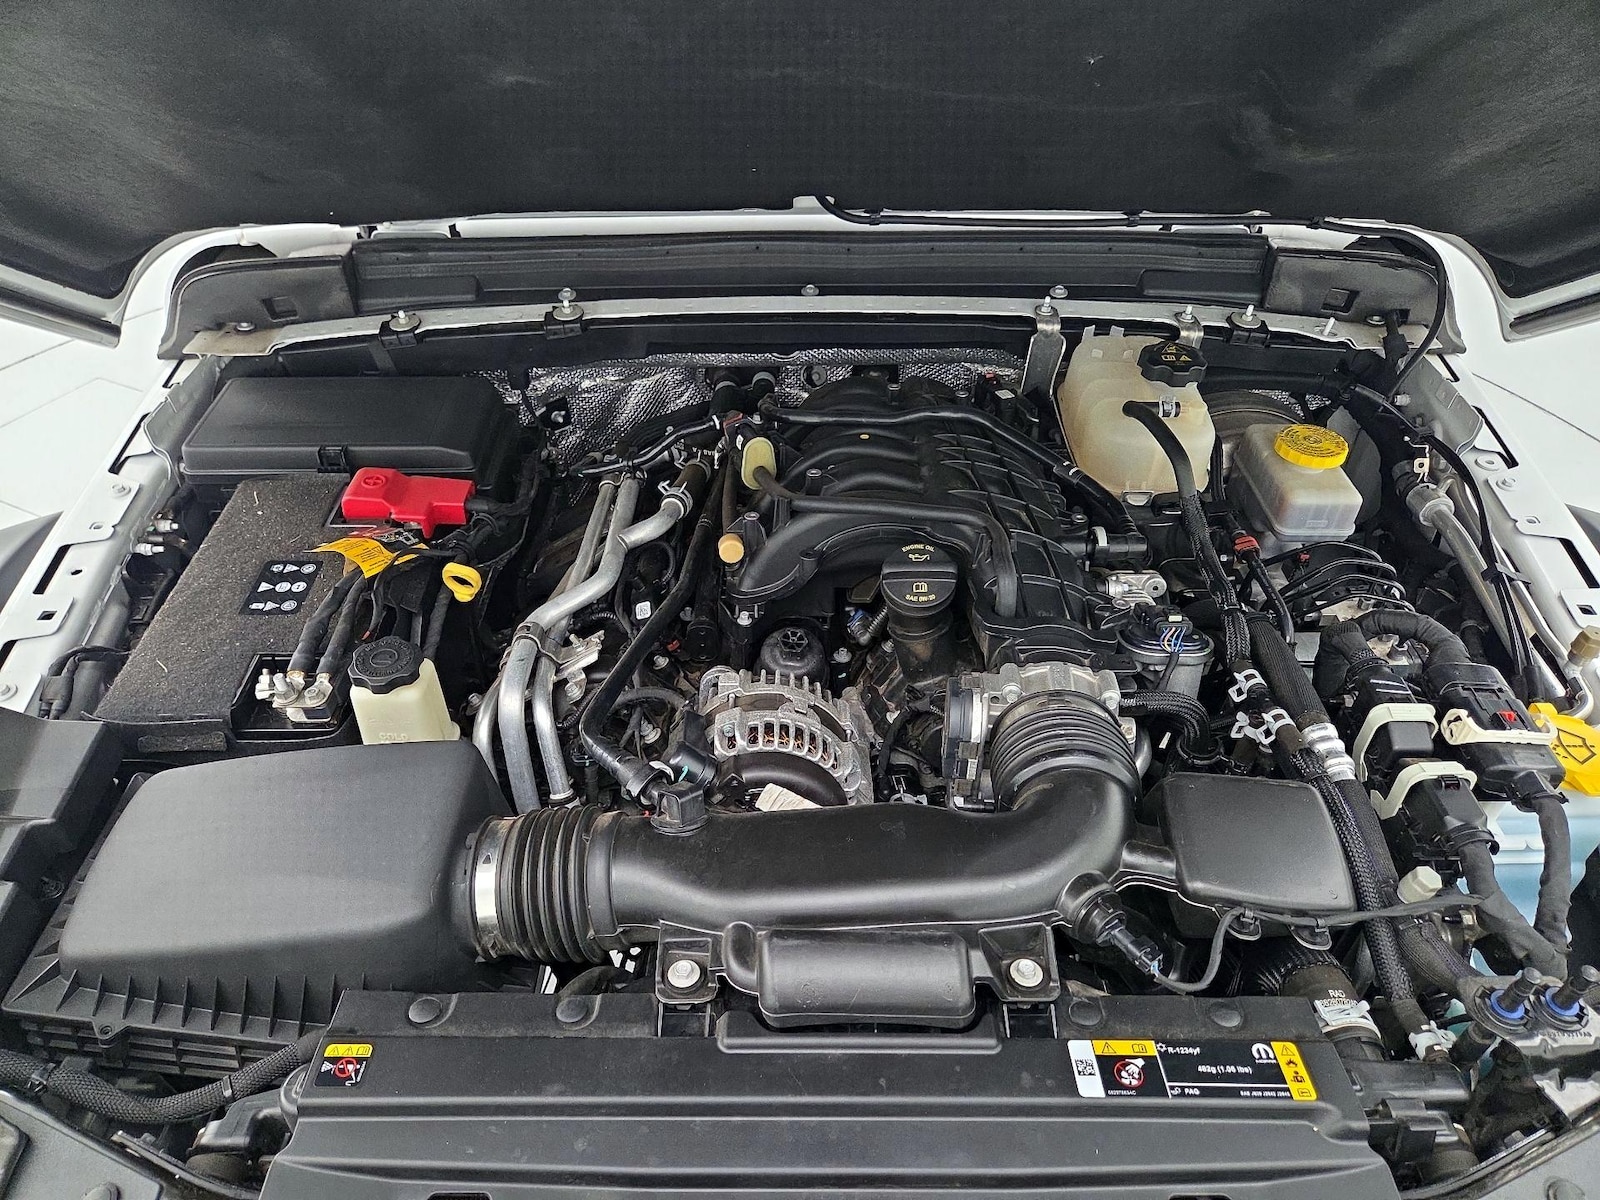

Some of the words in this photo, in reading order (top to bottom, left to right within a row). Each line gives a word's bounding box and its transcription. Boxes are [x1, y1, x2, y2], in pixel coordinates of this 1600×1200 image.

[901, 544, 924, 553] ENGINE
[925, 544, 935, 552] OIL
[905, 594, 918, 602] SAE
[1328, 989, 1346, 998] RAD
[1167, 1047, 1200, 1056] R-1234yf
[1184, 1087, 1200, 1095] PAG
